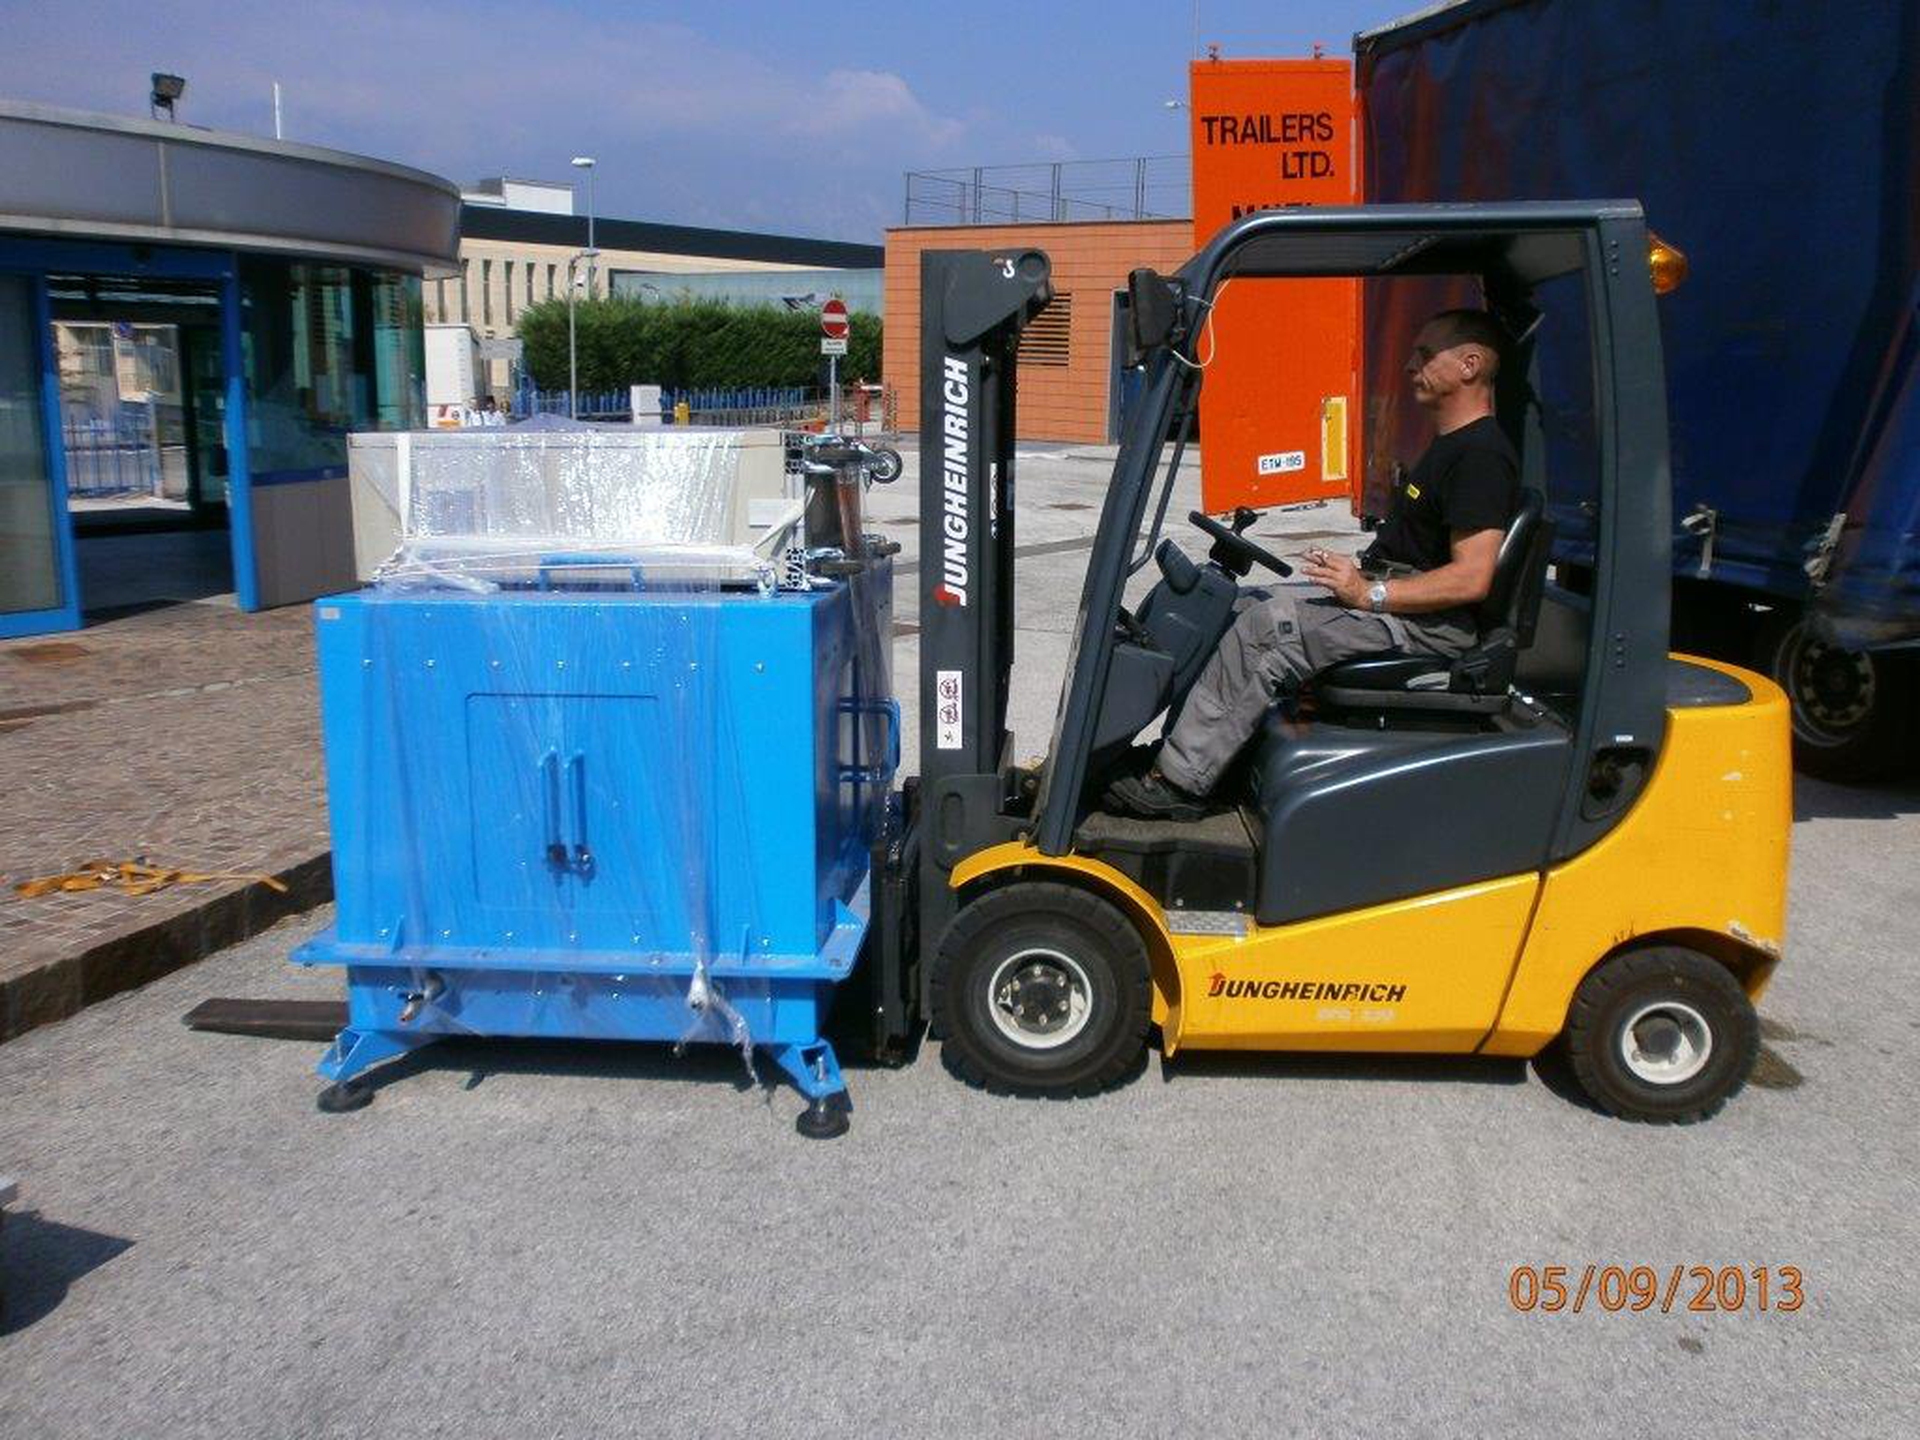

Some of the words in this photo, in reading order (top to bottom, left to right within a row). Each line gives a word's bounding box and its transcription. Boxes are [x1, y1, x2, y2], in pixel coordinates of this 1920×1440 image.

[1201, 112, 1334, 146] TRAILERS
[1281, 151, 1335, 179] LTD.
[943, 356, 969, 607] JUNGHEINRICH
[1207, 975, 1407, 1003] JUNGHEINRICH
